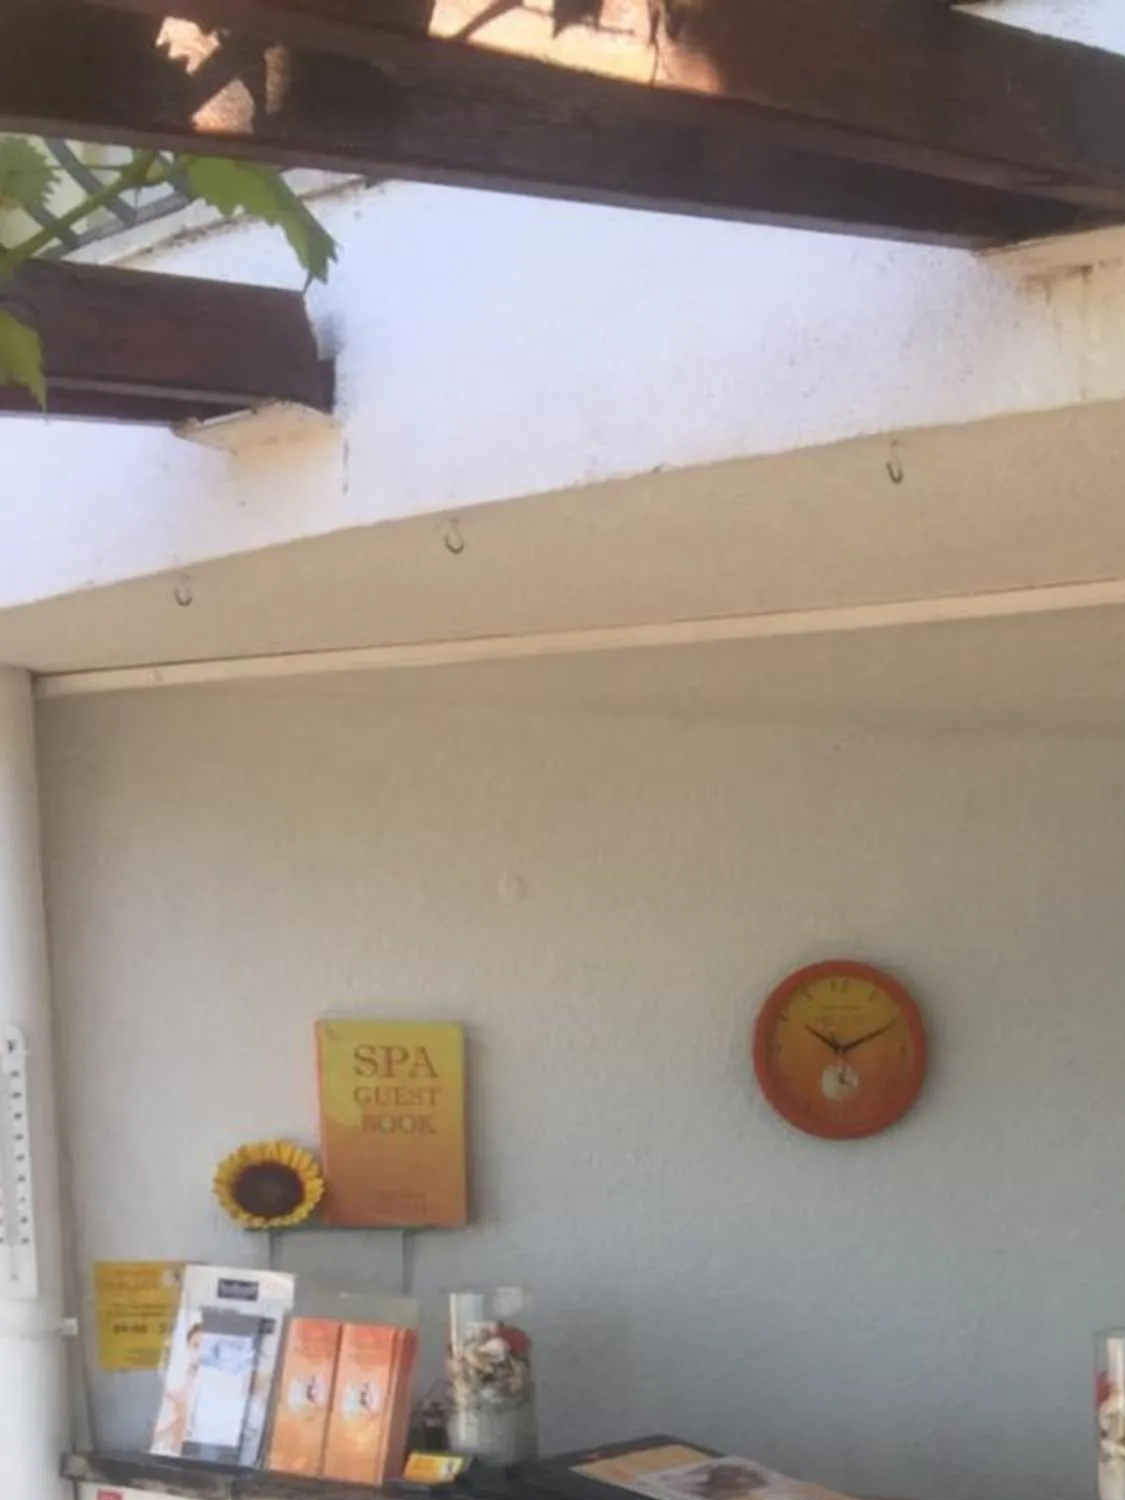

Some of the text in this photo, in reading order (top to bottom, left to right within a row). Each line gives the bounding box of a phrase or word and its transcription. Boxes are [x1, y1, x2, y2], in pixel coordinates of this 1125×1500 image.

[353, 1044, 439, 1078] SPA
[353, 1085, 441, 1107] GUEST
[361, 1113, 438, 1134] BOOK
